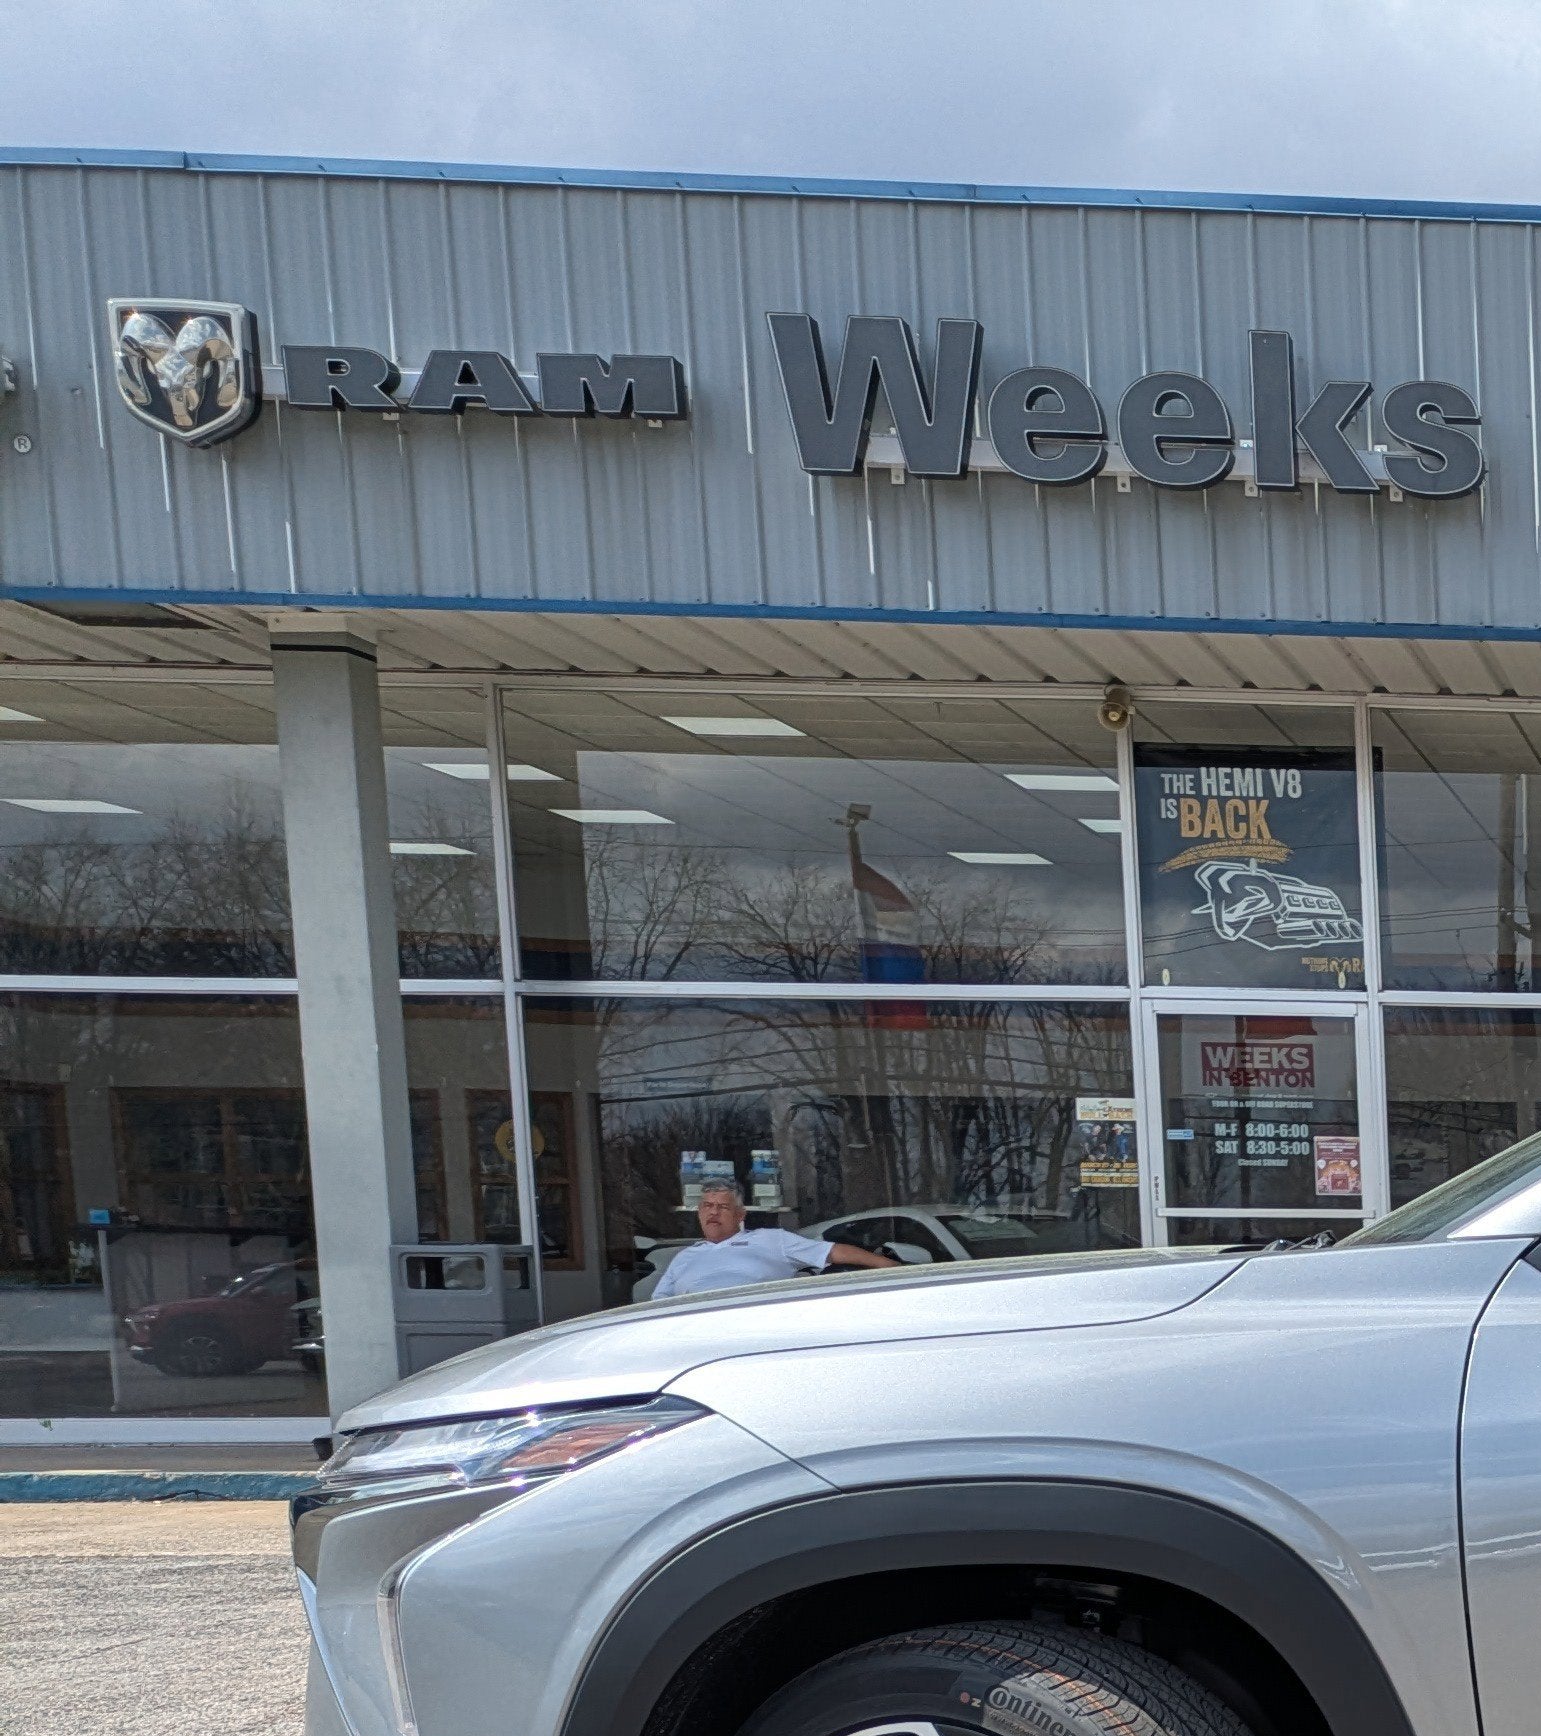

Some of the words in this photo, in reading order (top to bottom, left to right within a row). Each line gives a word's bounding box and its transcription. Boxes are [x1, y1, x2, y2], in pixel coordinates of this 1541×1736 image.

[281, 344, 686, 420] RAM
[765, 311, 1486, 500] Weeks
[1160, 773, 1196, 795] THE
[1200, 766, 1264, 797] HEMI
[1269, 768, 1302, 798] V8
[1160, 798, 1178, 819] IS
[1179, 797, 1272, 839] BACK
[1205, 1046, 1309, 1070] WEEKS
[1202, 1070, 1223, 1086] IN
[1229, 1071, 1315, 1088] BENTON
[1214, 1123, 1238, 1137] M-F
[1245, 1123, 1309, 1138] 8:00-6:00
[1215, 1140, 1239, 1154] SAT
[1246, 1140, 1310, 1155] 8:30-5:00
